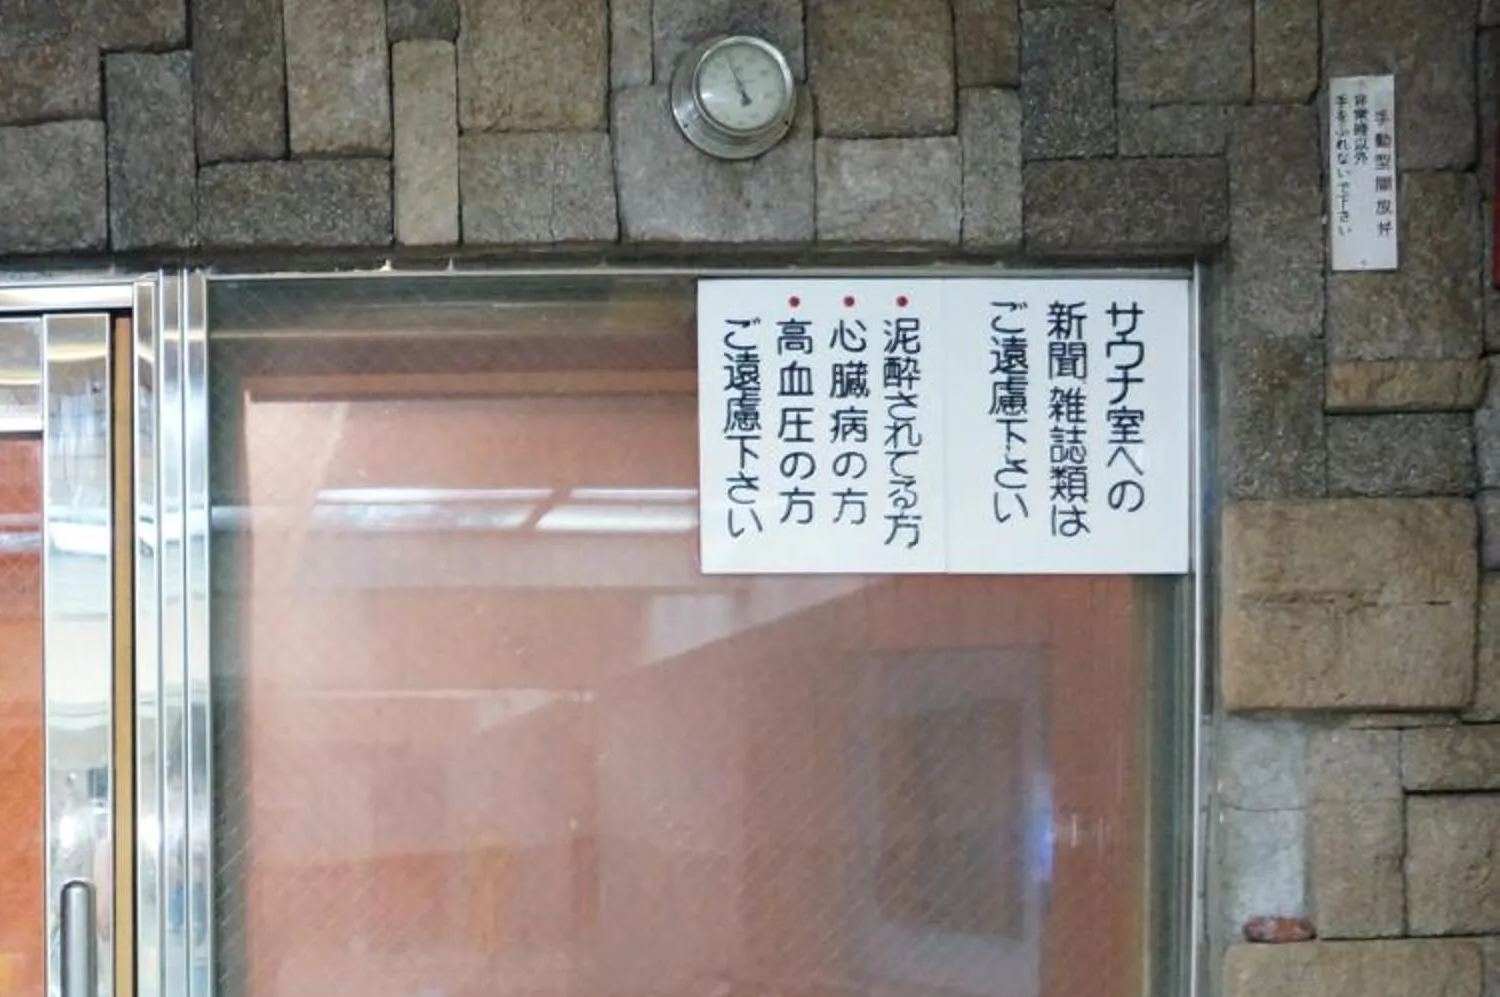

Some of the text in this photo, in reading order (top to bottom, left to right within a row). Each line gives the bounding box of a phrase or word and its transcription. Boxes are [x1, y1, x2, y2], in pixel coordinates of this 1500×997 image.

[723, 317, 763, 538] ご遠慮下さい
[776, 317, 816, 525] 高血圧の方
[829, 319, 871, 525] 心臓病の方
[883, 317, 923, 549] 泥酔されてる方
[988, 301, 1029, 523] ご遠慮下さい
[1104, 301, 1145, 513] サウナ室への
